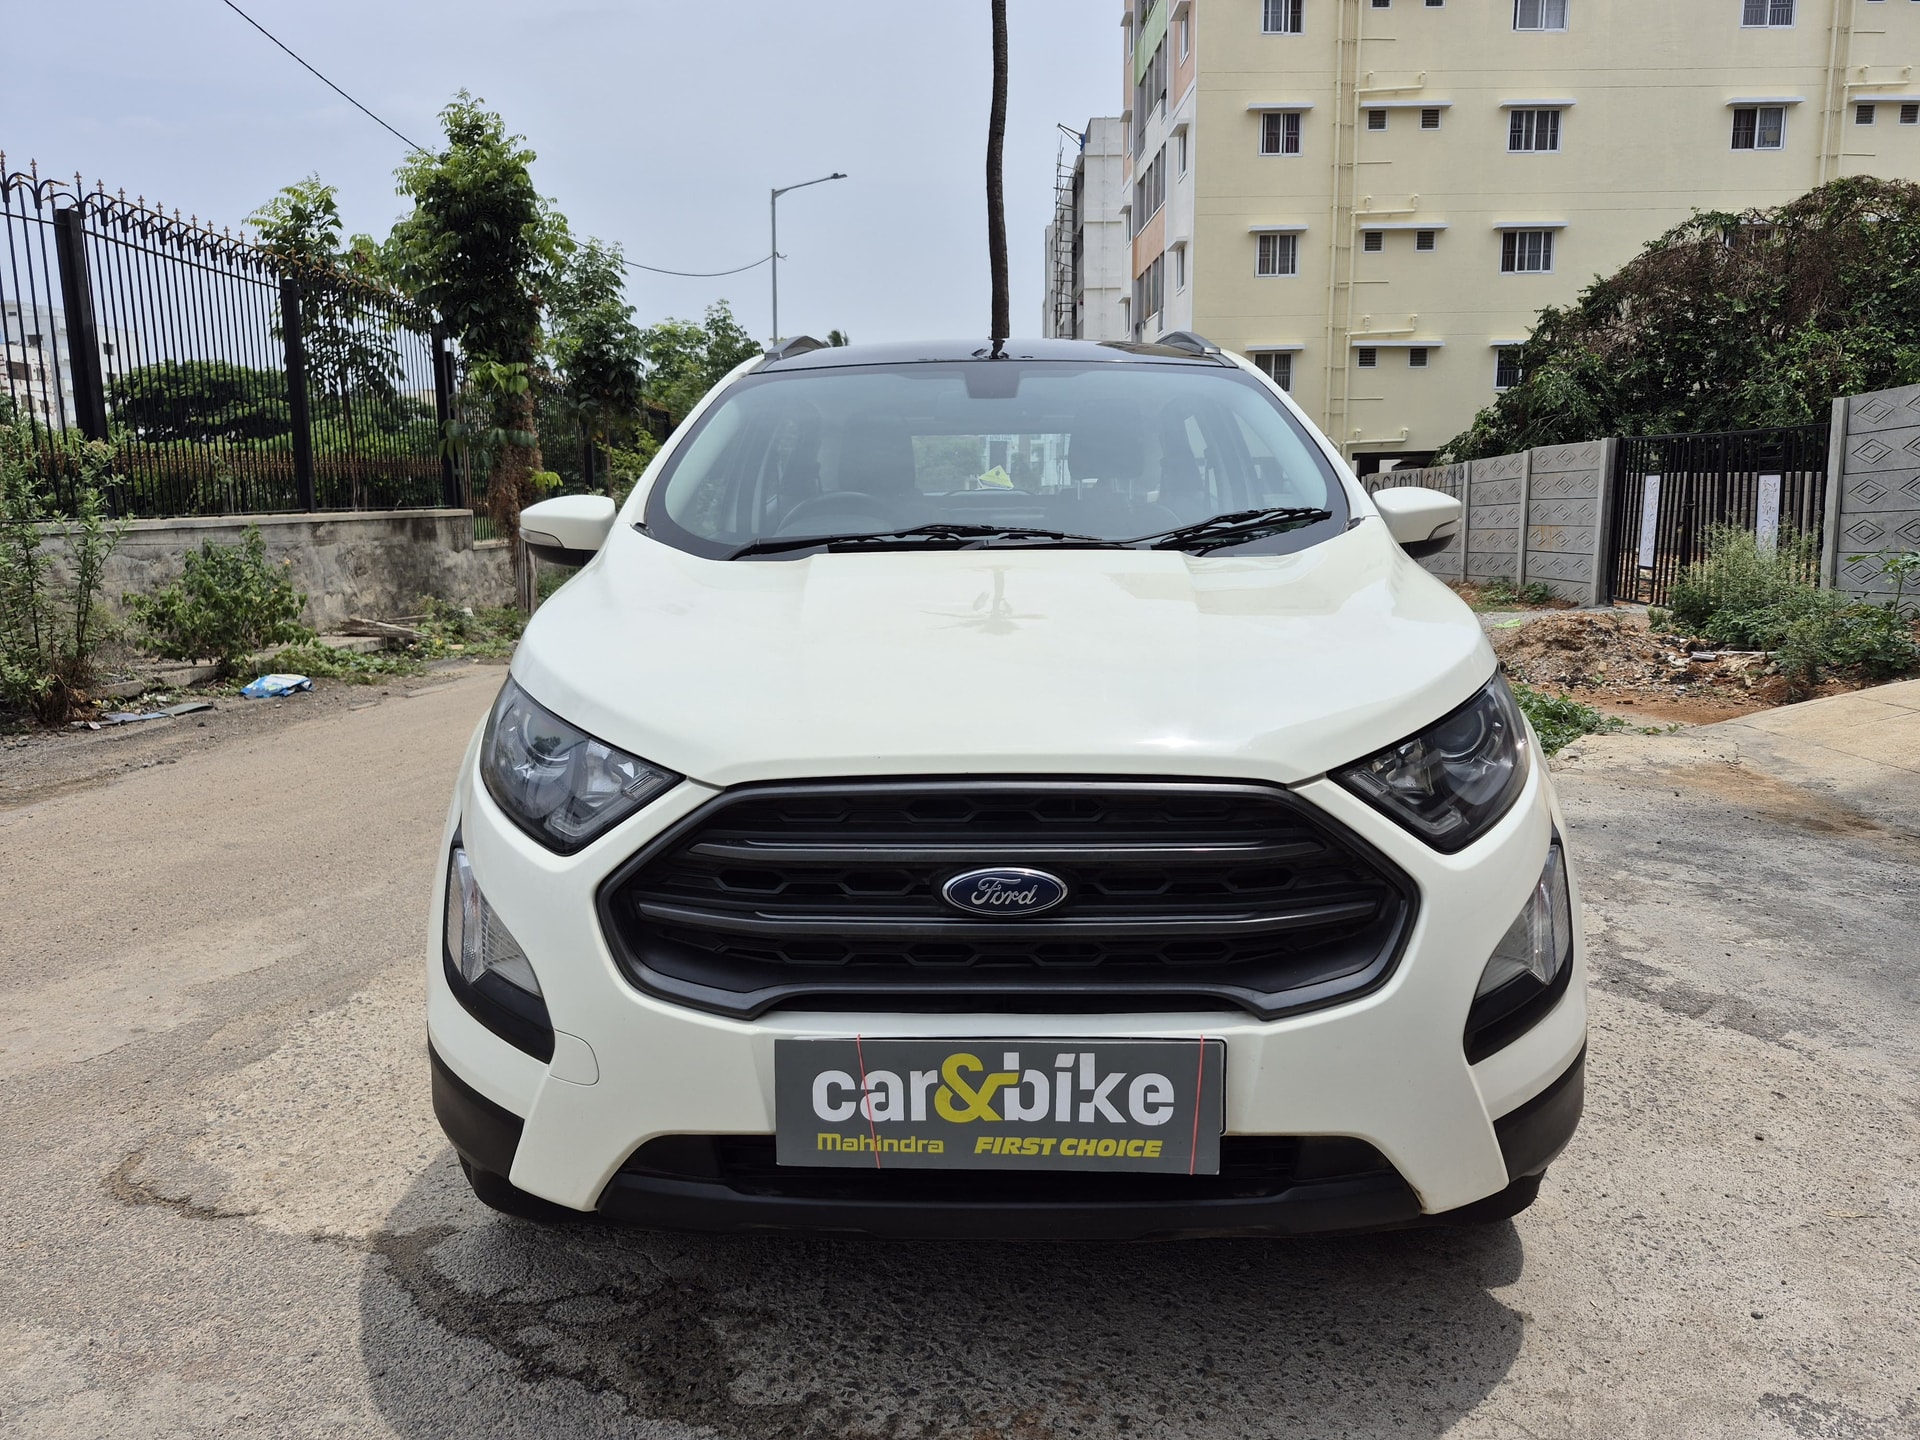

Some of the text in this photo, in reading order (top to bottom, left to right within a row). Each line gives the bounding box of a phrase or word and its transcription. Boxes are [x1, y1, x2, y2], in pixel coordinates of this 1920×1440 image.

[971, 877, 1038, 905] Ford
[811, 1051, 1175, 1126] car&bike
[817, 1132, 944, 1154] Mahindra
[974, 1136, 1163, 1158] FIRST CHOICE
